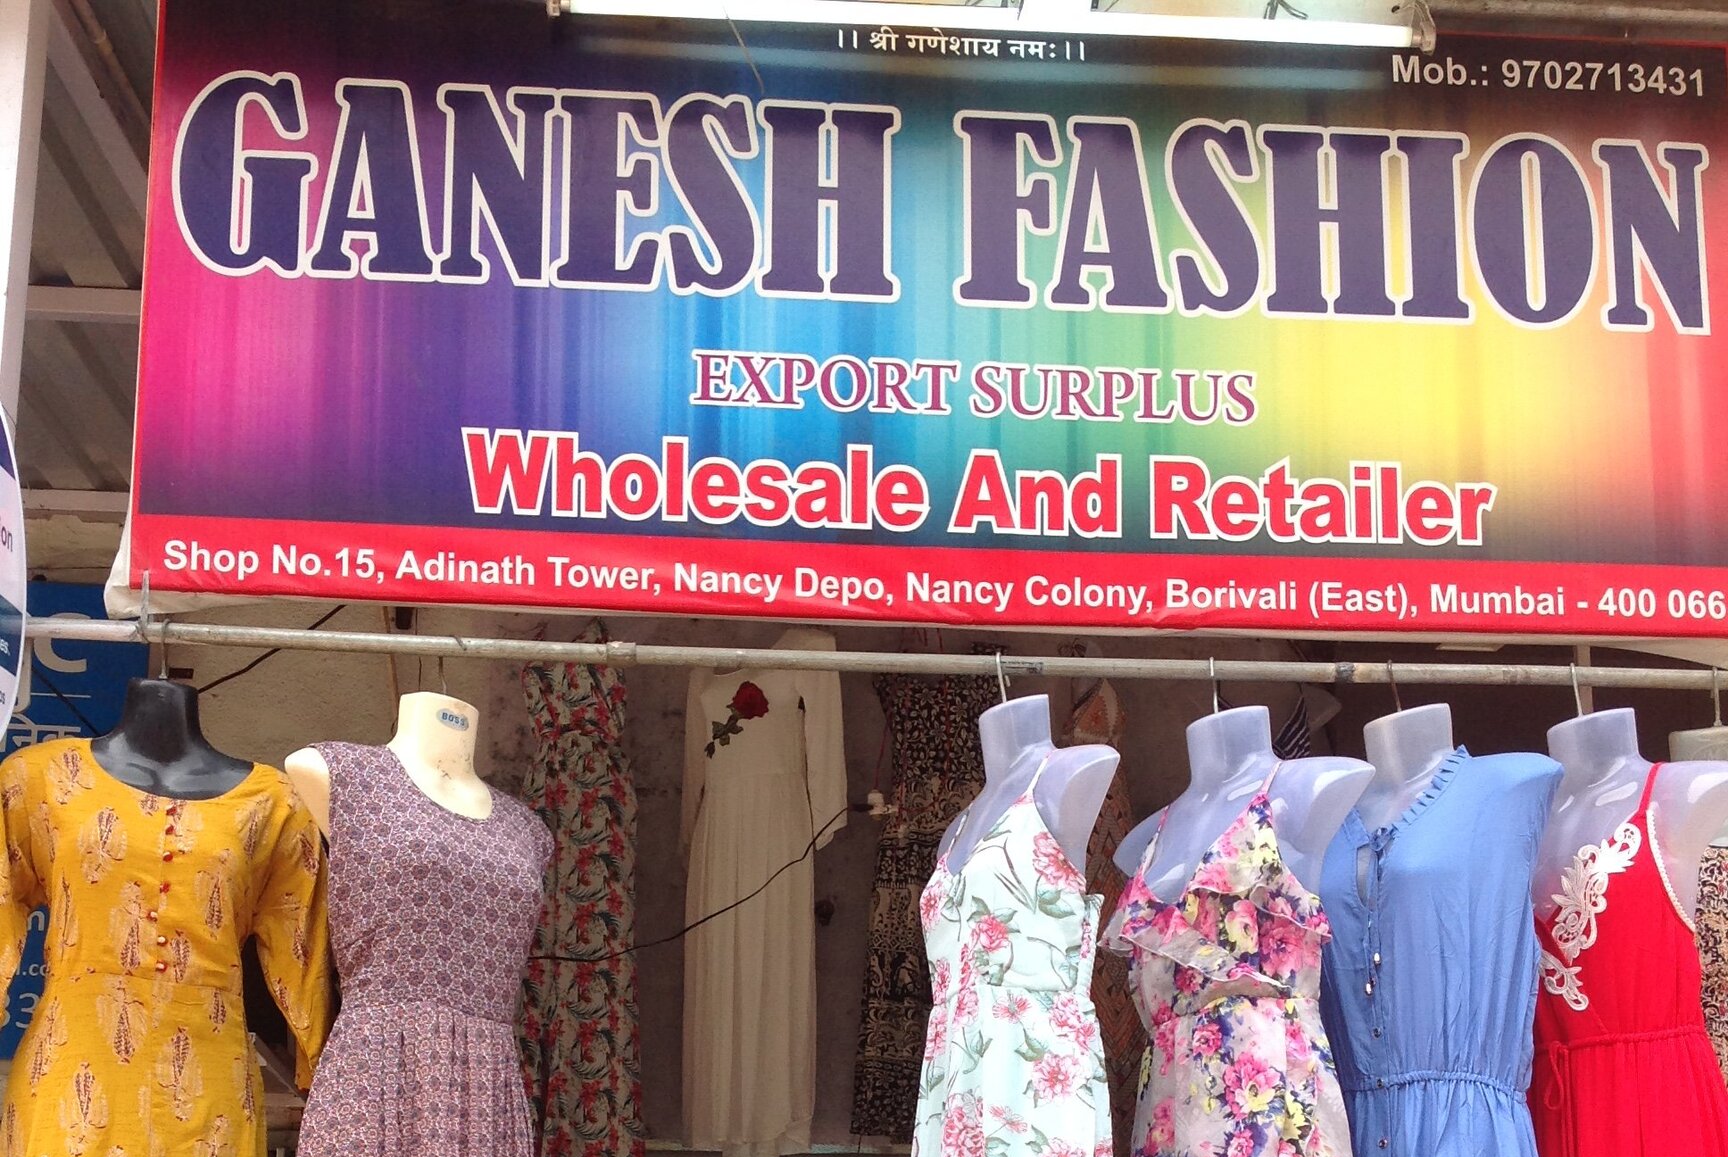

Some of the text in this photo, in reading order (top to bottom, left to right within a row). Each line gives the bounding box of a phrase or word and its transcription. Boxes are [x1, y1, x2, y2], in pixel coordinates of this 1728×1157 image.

[869, 26, 899, 52] श्री
[905, 27, 1002, 57] गणेशाय
[1391, 54, 1704, 97] Mob.: 9702713431
[172, 70, 1712, 335] GANESH FASHION
[688, 348, 1257, 426] EXPORT SURPLUS
[461, 427, 1498, 546] Wholesale And Retailer
[163, 539, 260, 580] Shop
[272, 543, 385, 584] No.15,
[395, 549, 536, 586] Adinath
[547, 556, 662, 597] Tower,
[674, 562, 783, 603] Nancy
[794, 566, 894, 606] Depo,
[905, 571, 1014, 613] Nancy
[1025, 575, 1154, 614] Colony,
[1166, 577, 1298, 611] Borivali
[1308, 581, 1418, 619] (East),
[1430, 584, 1566, 615] Mumbai
[1597, 586, 1657, 618] 400
[1667, 588, 1727, 621] 066
